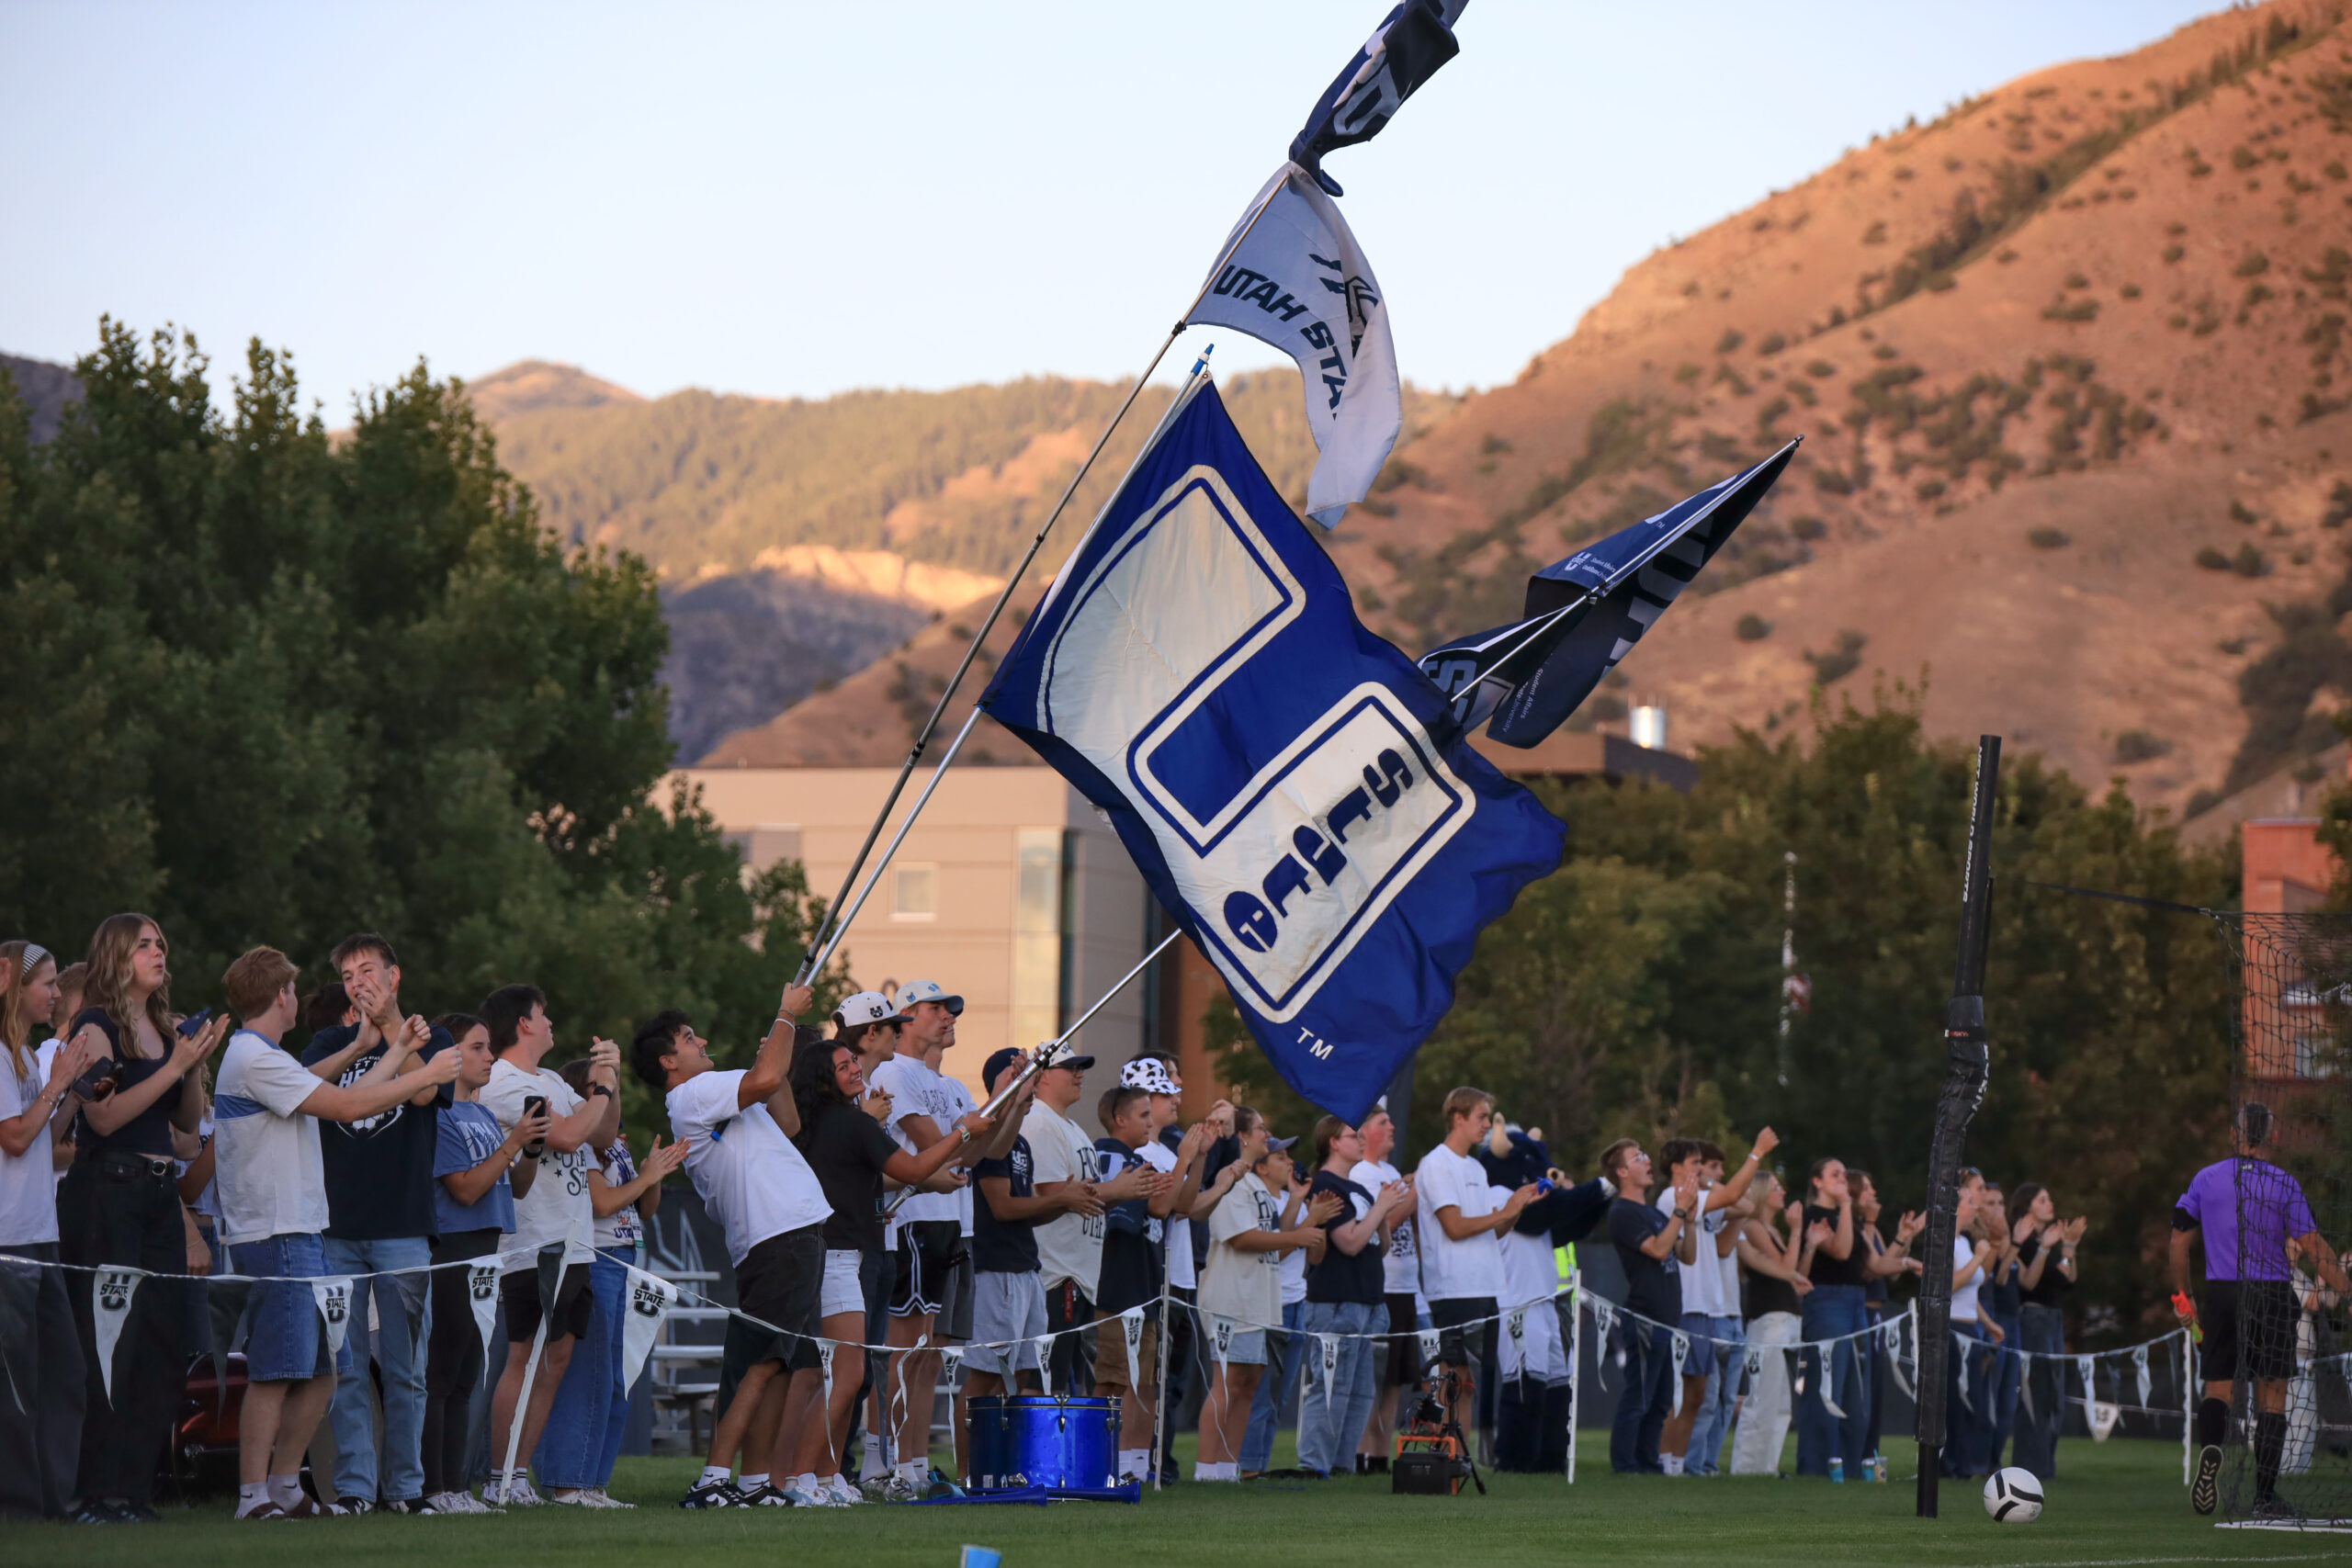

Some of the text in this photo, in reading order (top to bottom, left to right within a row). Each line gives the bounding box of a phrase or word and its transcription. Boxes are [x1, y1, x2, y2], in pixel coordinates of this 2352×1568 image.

[1213, 265, 1348, 421] UTAH STA
[1521, 668, 1544, 719] Student Affairs
[1970, 781, 1980, 837] WORLD
[1962, 840, 1974, 903] SPORTS
[1296, 1026, 1334, 1061] TM
[100, 1283, 128, 1300] STATE
[472, 1276, 494, 1288] STATE
[634, 1289, 665, 1308] STATE
[326, 1297, 345, 1310] STATE
